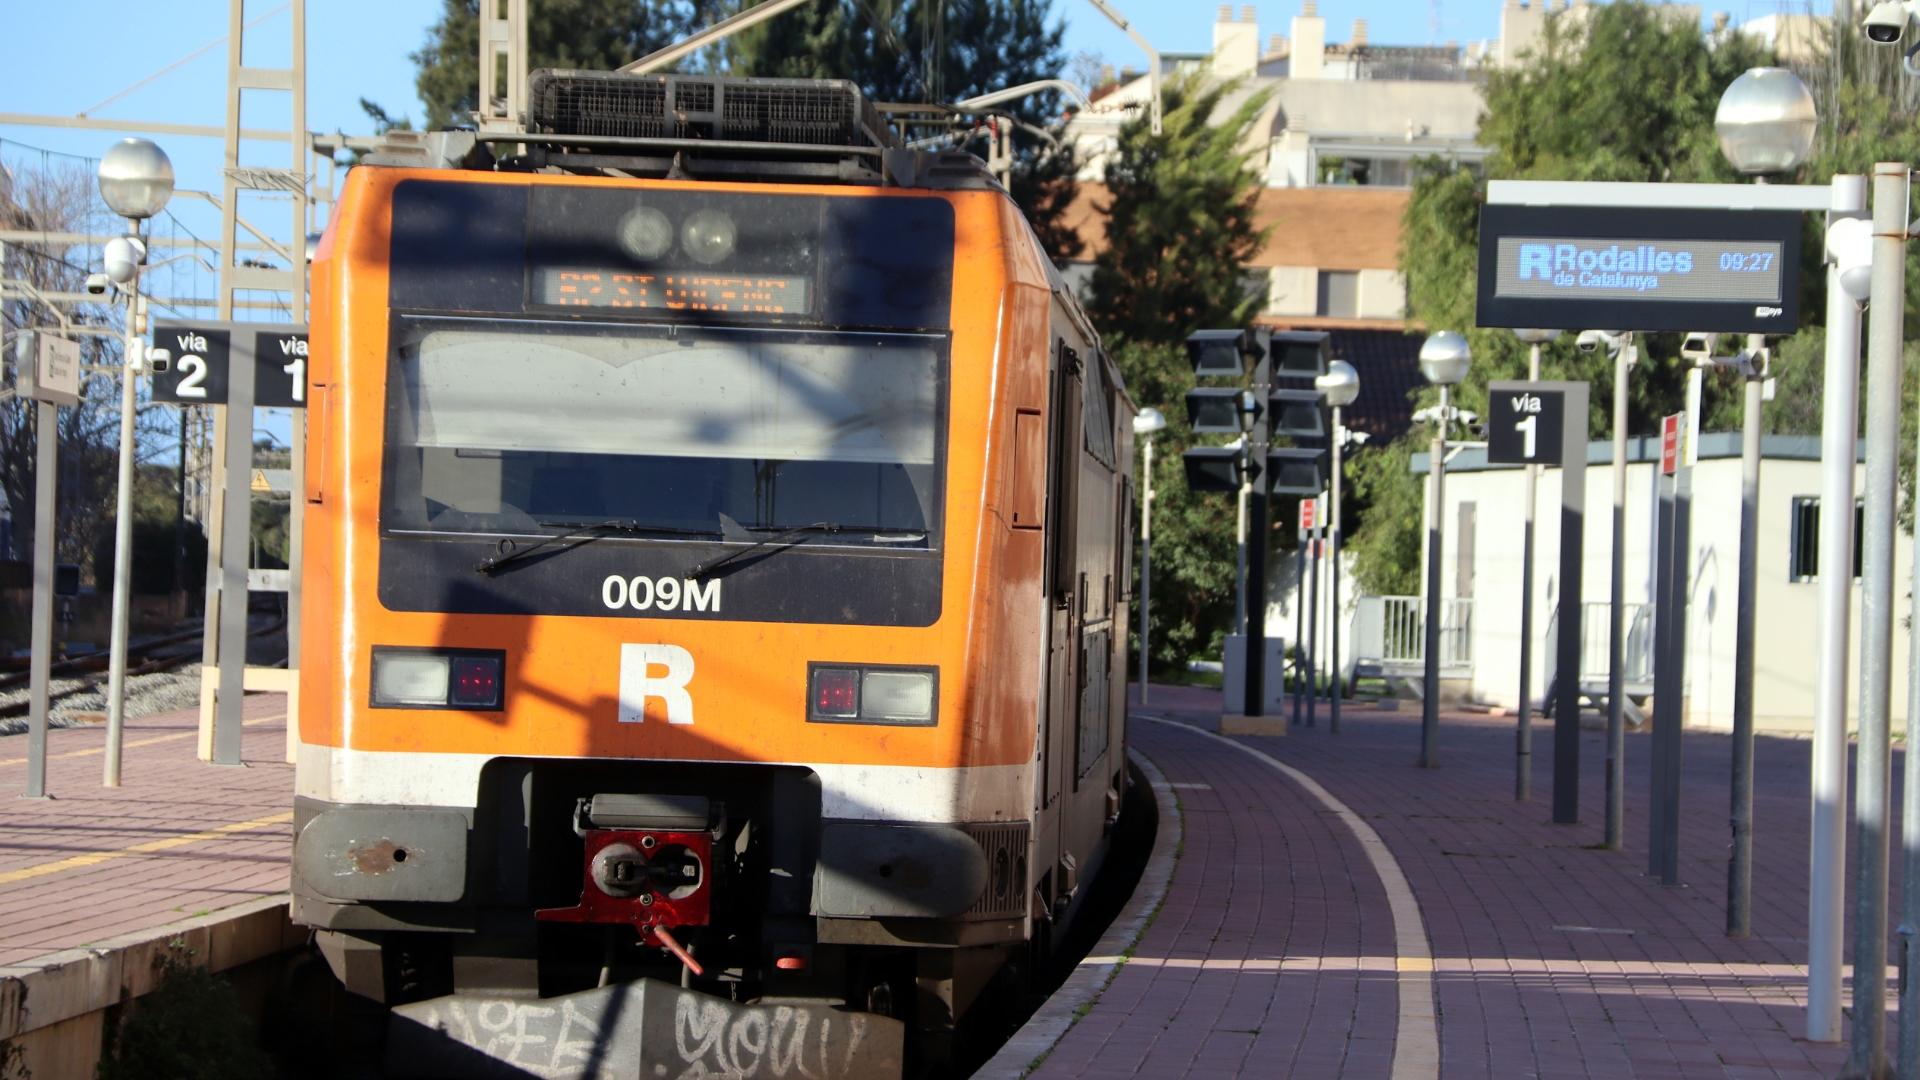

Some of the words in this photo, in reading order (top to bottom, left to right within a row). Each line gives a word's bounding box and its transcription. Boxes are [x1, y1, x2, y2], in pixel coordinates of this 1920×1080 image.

[1519, 243, 1553, 280] R
[1718, 251, 1775, 272] 09:27
[1554, 270, 1575, 287] de
[1578, 270, 1658, 292] Catalunya
[177, 332, 208, 352] via
[279, 336, 309, 356] via
[175, 354, 207, 398] 2
[283, 358, 305, 401] 1
[1511, 392, 1542, 413] via
[1515, 415, 1536, 458] 1
[602, 574, 722, 612] 009M
[618, 643, 695, 724] R
